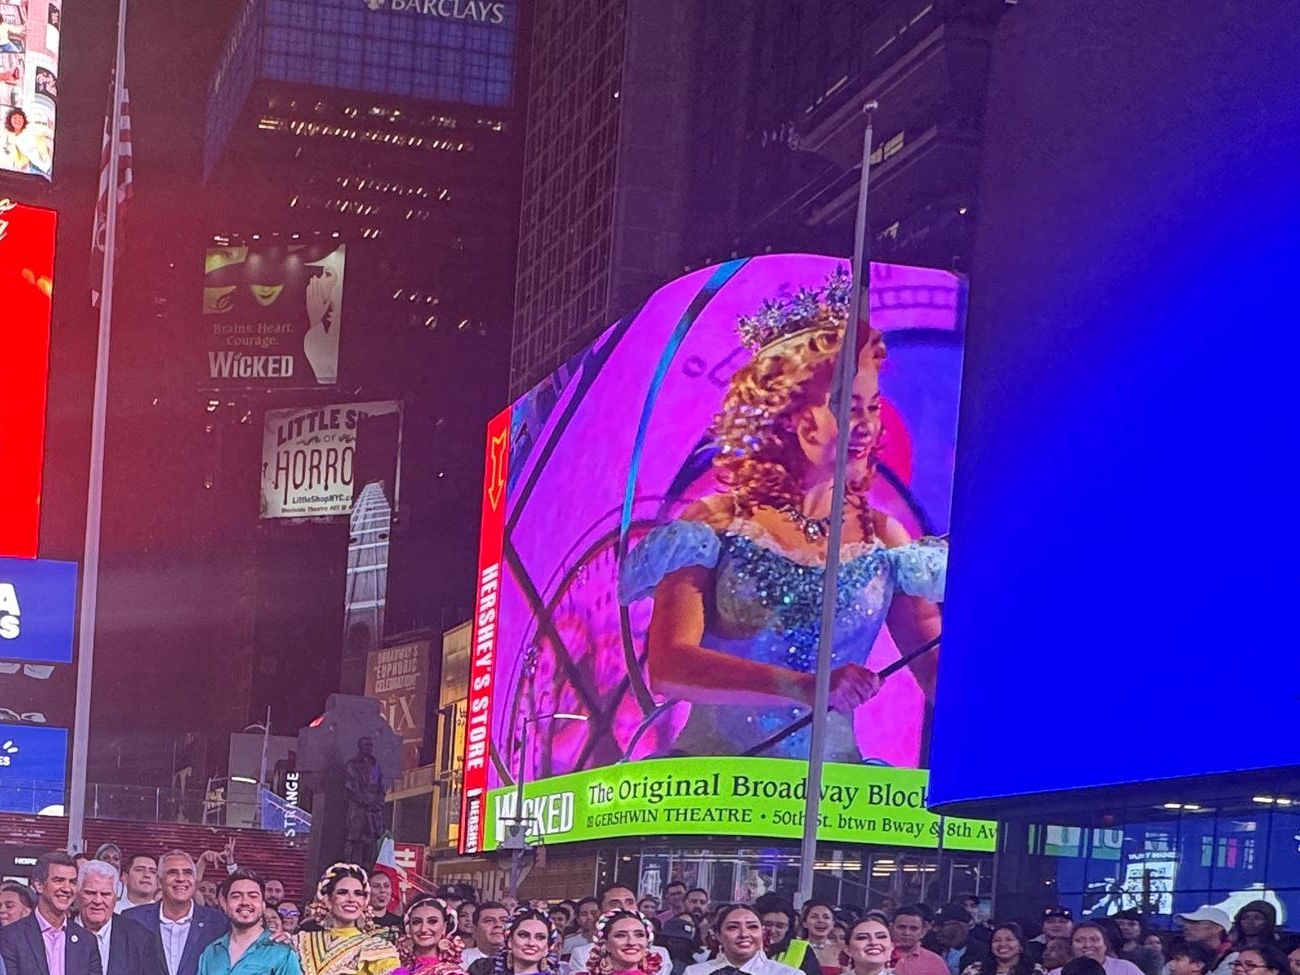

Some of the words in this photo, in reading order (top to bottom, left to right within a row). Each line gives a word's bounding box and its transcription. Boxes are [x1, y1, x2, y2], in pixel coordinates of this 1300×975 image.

[391, 0, 504, 24] BARCLAYS
[213, 323, 256, 335] Brains.
[257, 322, 294, 333] Heart.
[227, 335, 279, 349] Courage.
[277, 408, 341, 446] LITTLE
[323, 434, 336, 443] OF
[471, 562, 499, 691] HERSHEY'S
[466, 694, 489, 771] STORE
[284, 772, 299, 837] STRANGE
[589, 782, 614, 805] The
[618, 772, 721, 804] Original
[494, 790, 575, 842] WCKED
[595, 808, 659, 828] GERSHWIN
[663, 807, 753, 823] THEATRE
[772, 810, 806, 826] 50th
[838, 814, 876, 832] btwn
[882, 818, 924, 839] Bway
[929, 822, 941, 838] &
[946, 823, 972, 838] 8th
